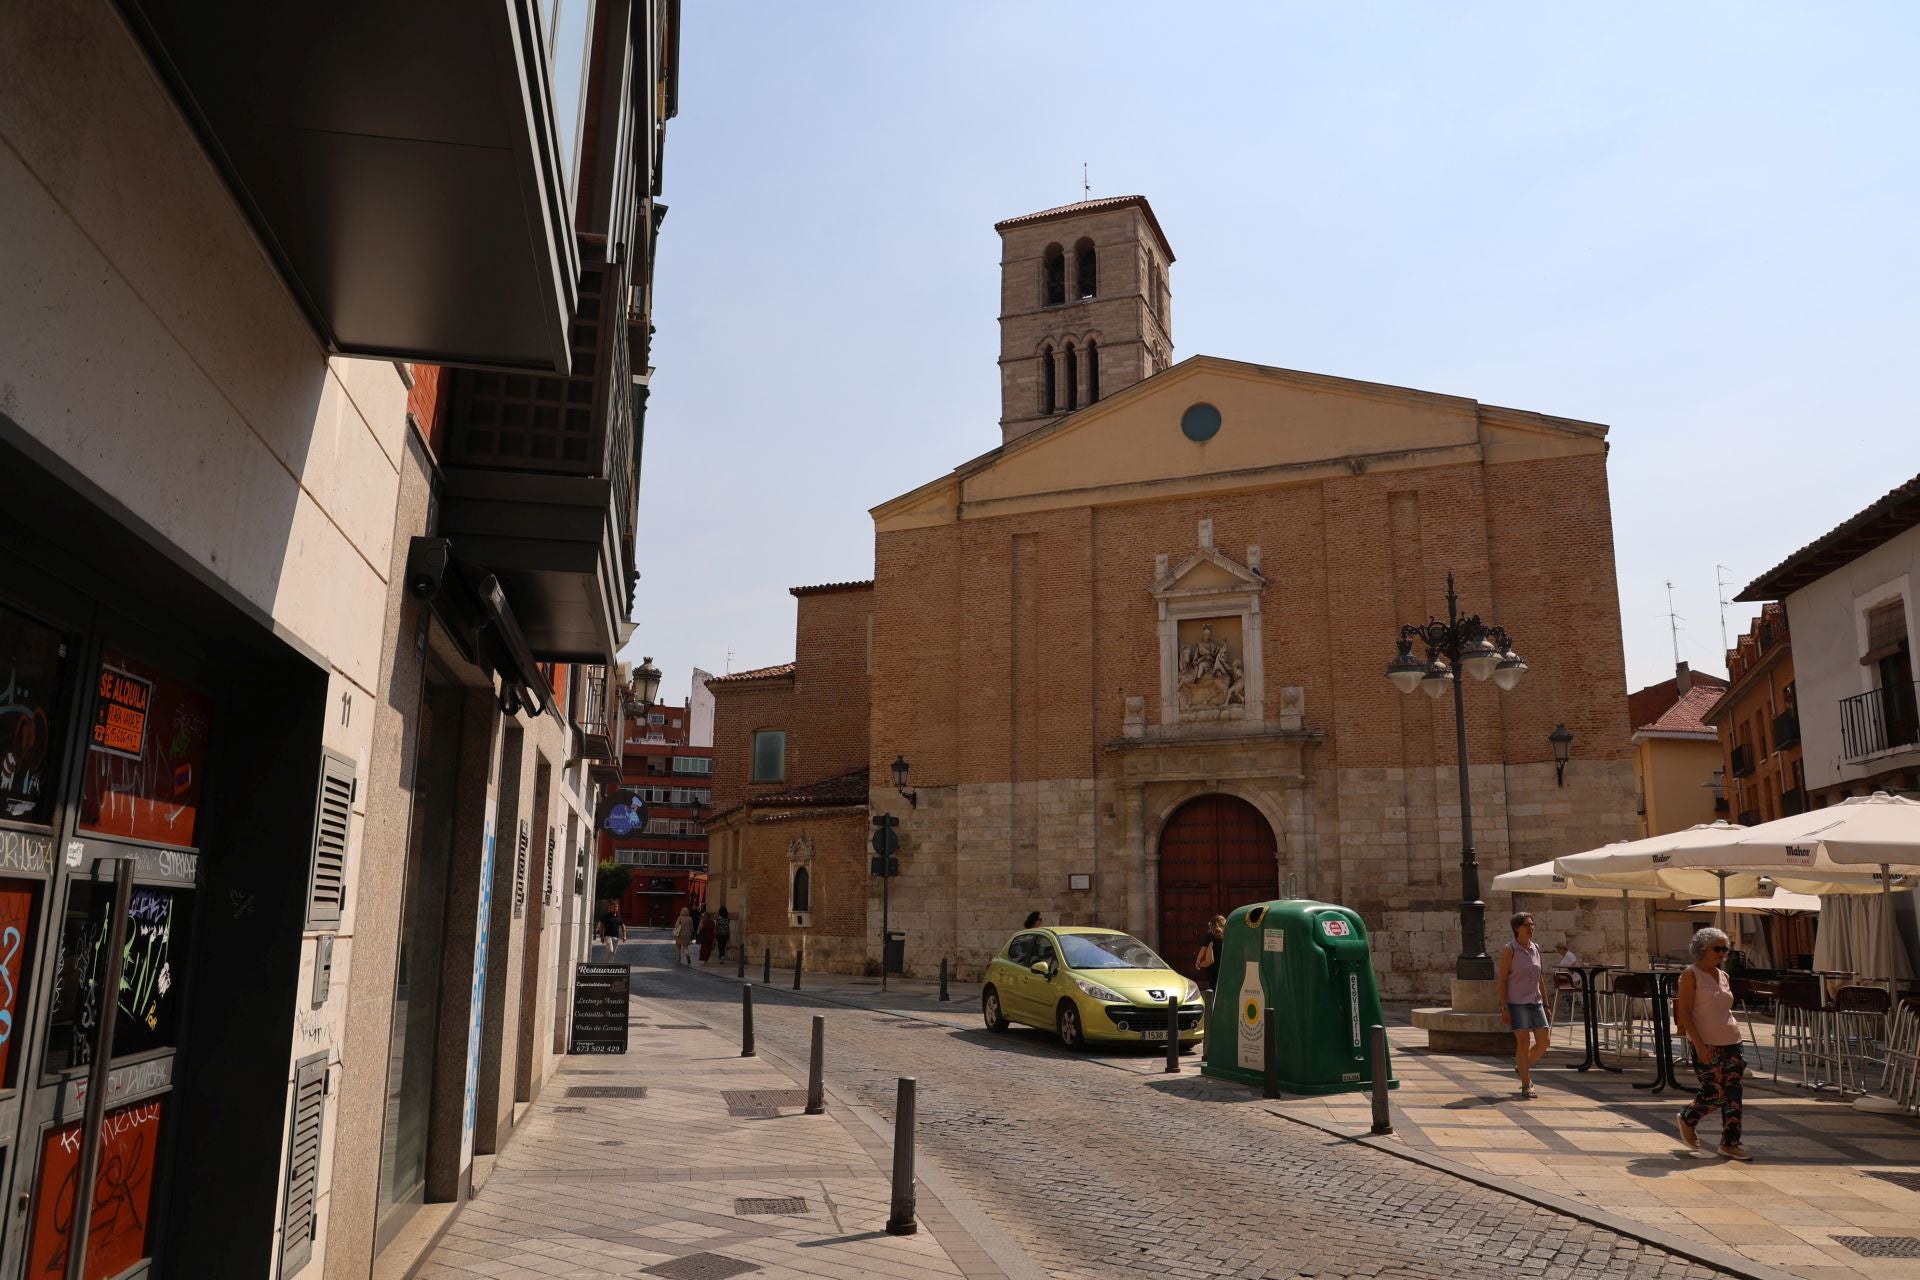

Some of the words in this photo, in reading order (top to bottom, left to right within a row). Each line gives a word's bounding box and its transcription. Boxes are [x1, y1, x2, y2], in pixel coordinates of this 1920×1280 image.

[101, 673, 114, 698] SE
[112, 678, 146, 709] ALQUILA
[1786, 846, 1811, 857] Mahou
[578, 965, 627, 975] Restaurante
[577, 997, 603, 1006] Lechazo
[604, 997, 625, 1005] Asado
[605, 1010, 626, 1018] Asado
[1350, 976, 1360, 1046] ecovidrio
[1148, 1031, 1164, 1040] 1538
